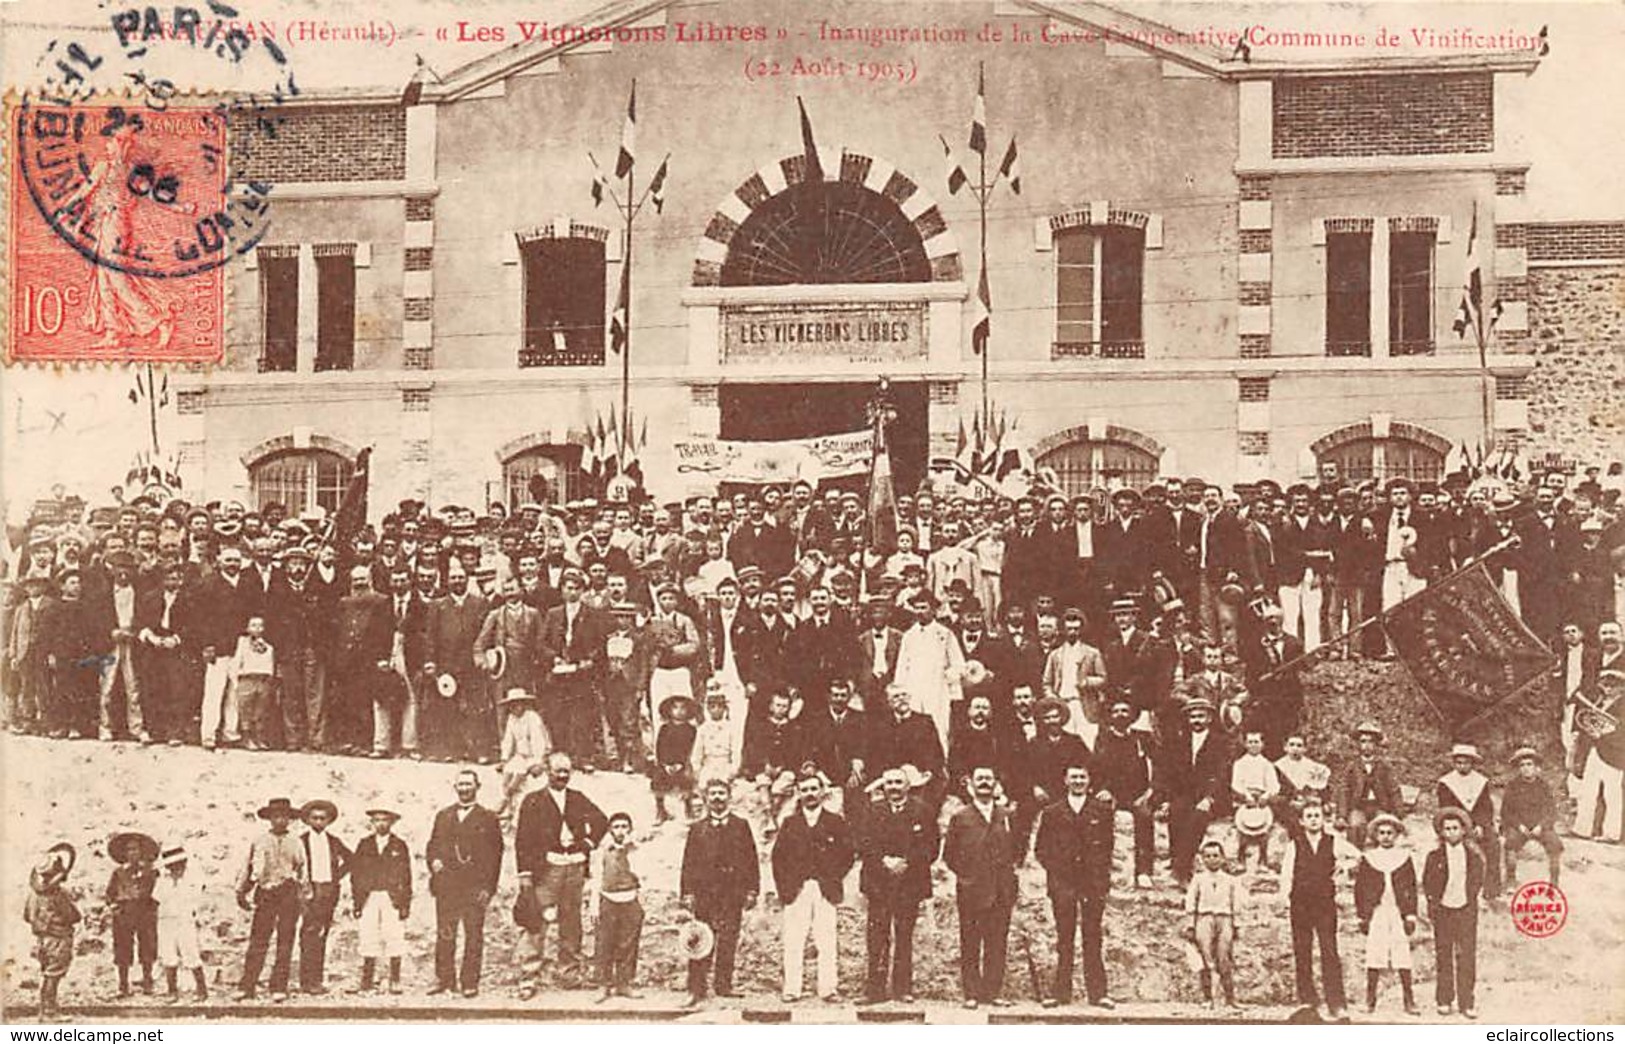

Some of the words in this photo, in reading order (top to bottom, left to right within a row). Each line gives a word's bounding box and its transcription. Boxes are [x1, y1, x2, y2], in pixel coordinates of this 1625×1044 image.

[741, 322, 767, 344] LES
[774, 322, 850, 344] VIGNERONS
[858, 321, 910, 342] LIBRES
